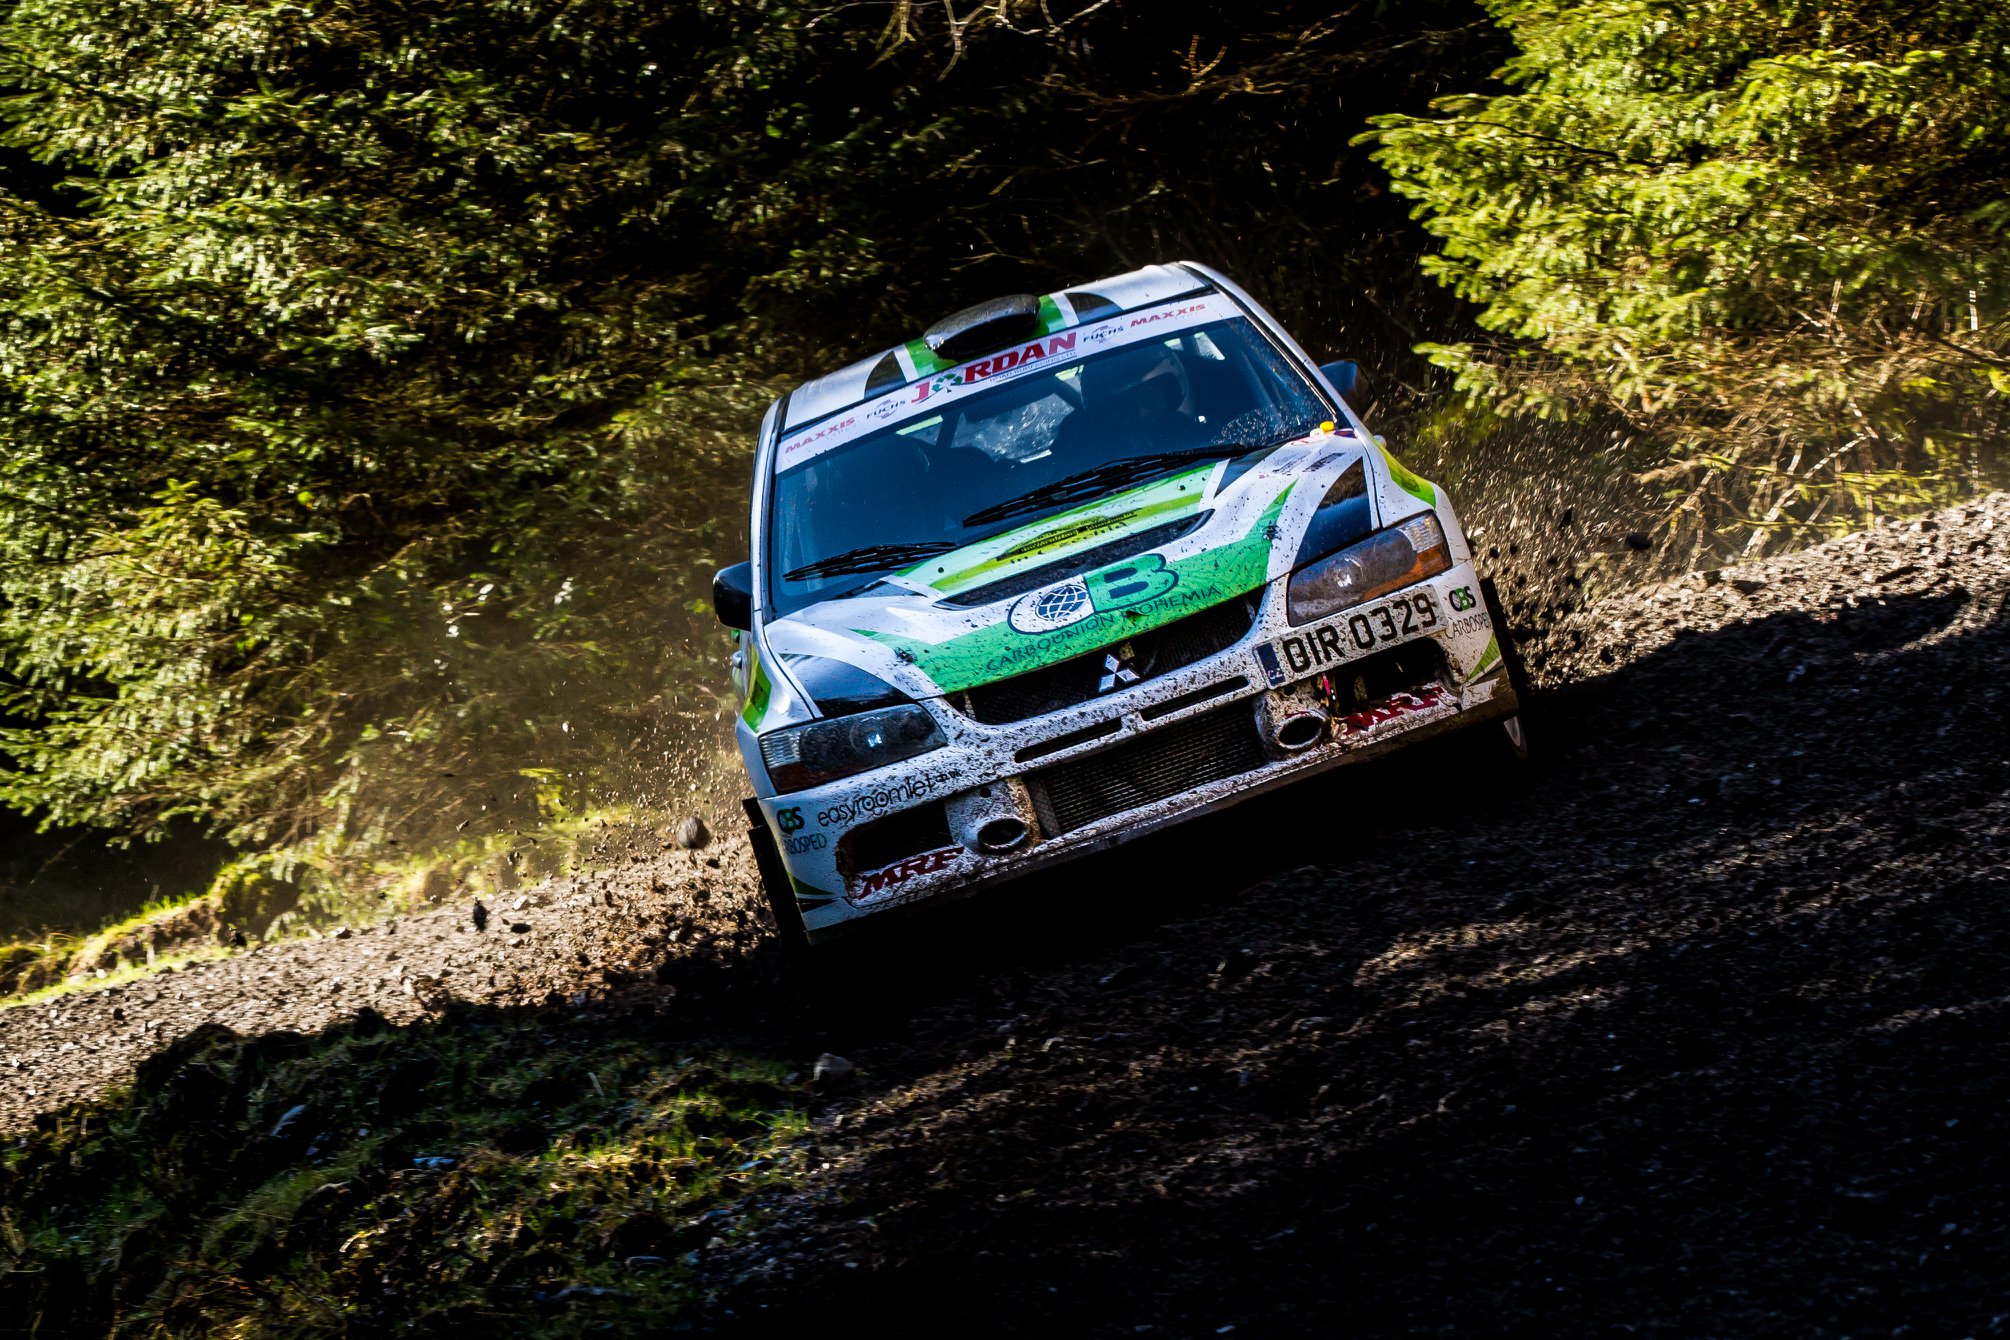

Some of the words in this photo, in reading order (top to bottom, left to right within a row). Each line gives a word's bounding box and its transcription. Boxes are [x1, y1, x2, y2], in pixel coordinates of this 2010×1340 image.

[1131, 304, 1205, 327] MAXXIS
[1083, 325, 1124, 342] FUCHS
[911, 332, 1077, 403] JRDAN
[856, 400, 906, 420] FUCHS
[785, 417, 855, 454] MAXXIS
[1449, 586, 1476, 611] CBS
[985, 613, 1115, 672] CARBOUNION
[858, 846, 966, 900] MRF
